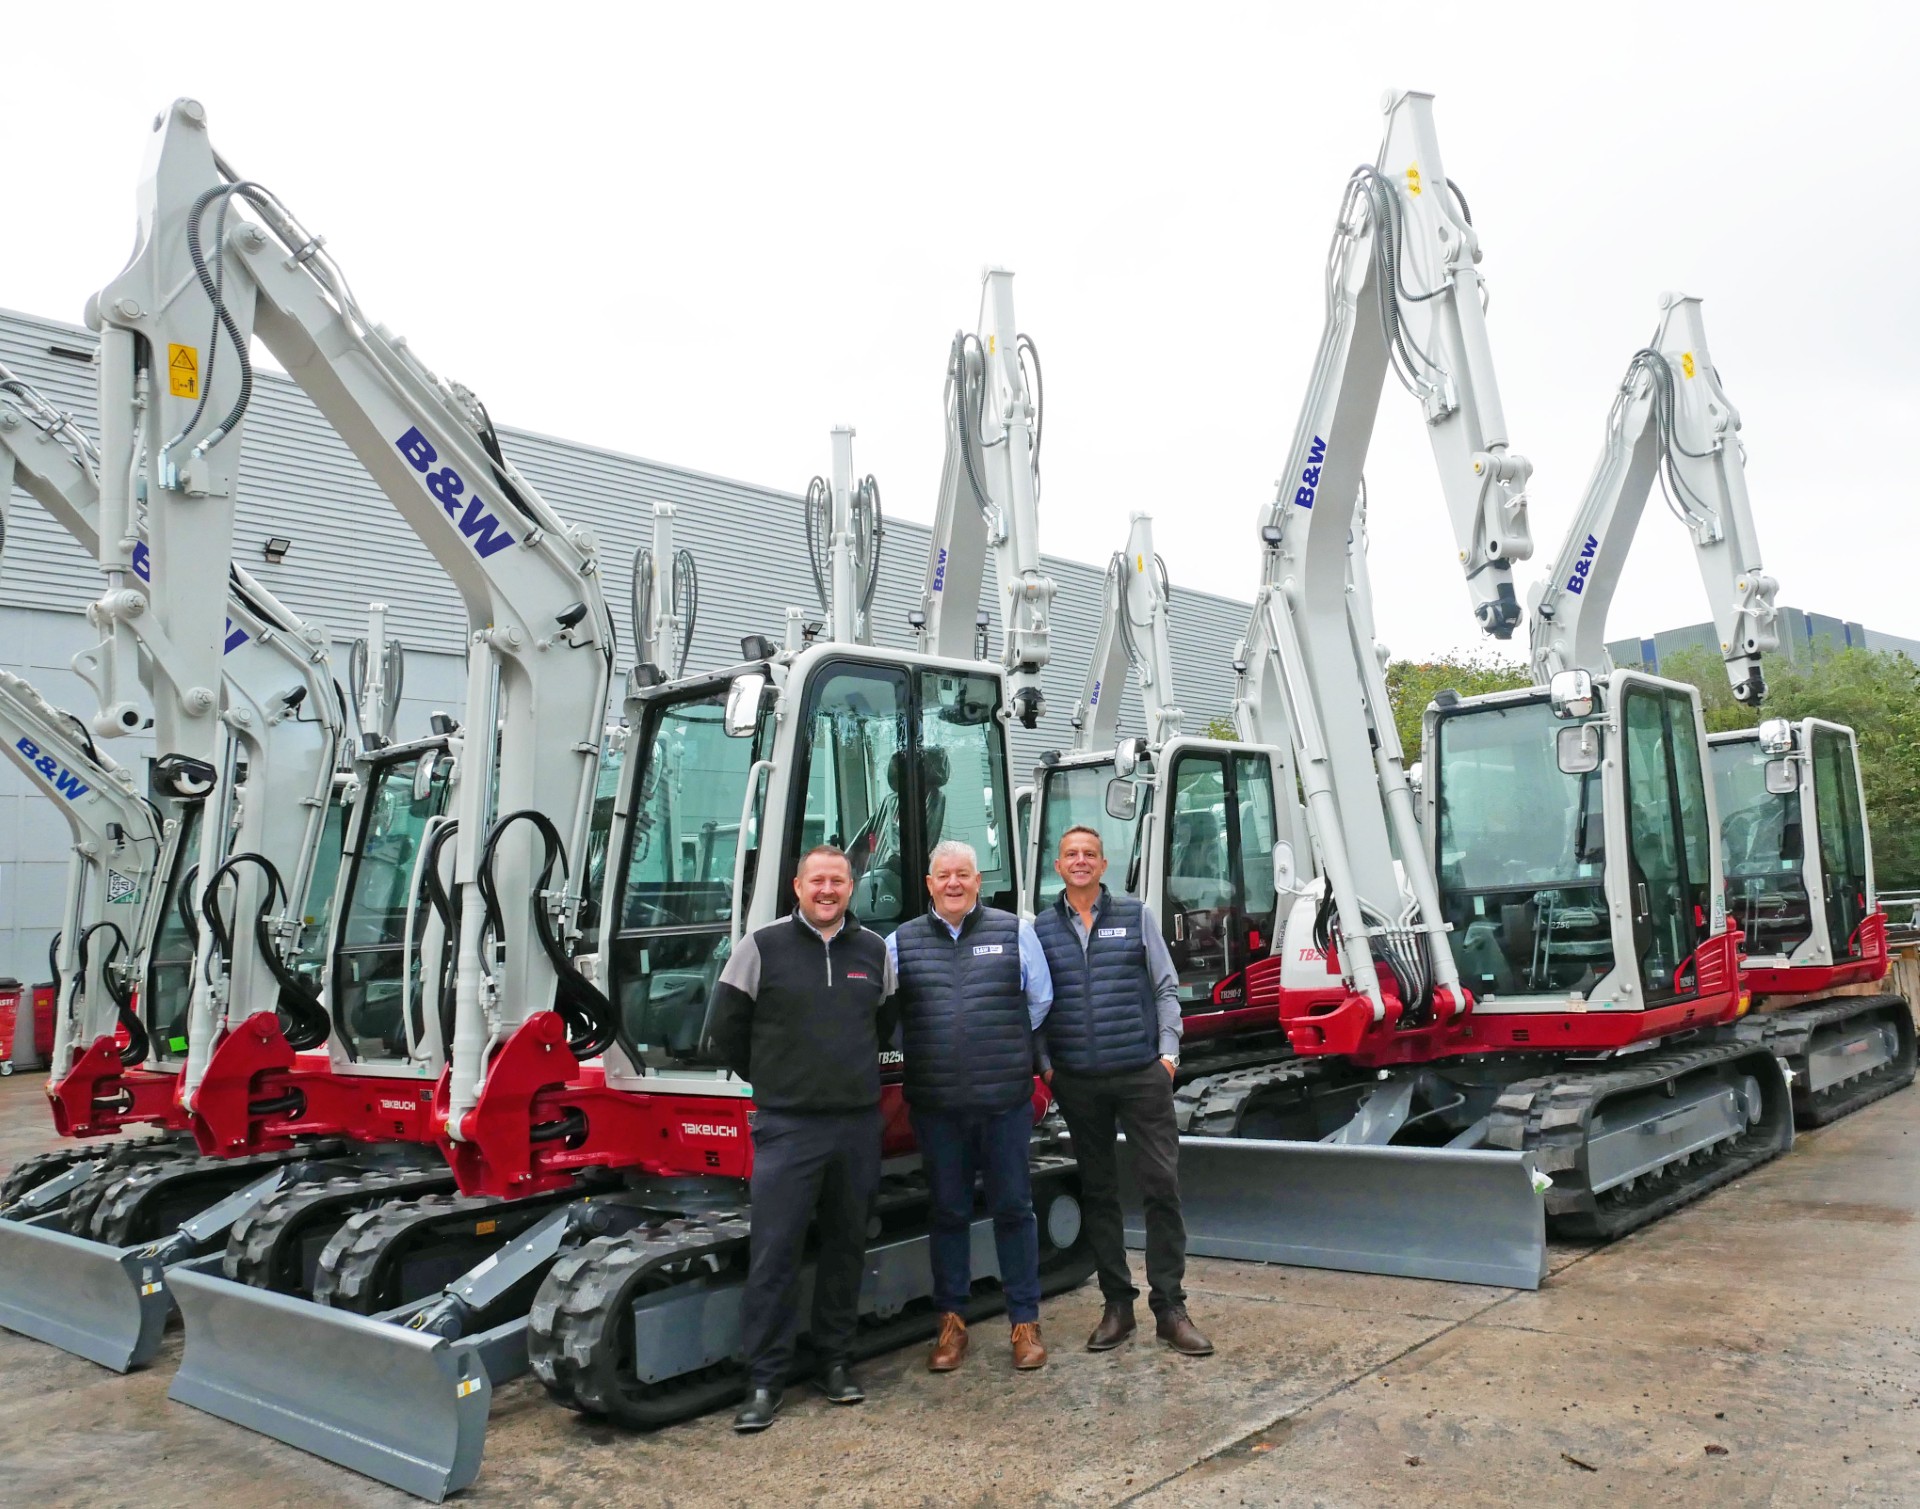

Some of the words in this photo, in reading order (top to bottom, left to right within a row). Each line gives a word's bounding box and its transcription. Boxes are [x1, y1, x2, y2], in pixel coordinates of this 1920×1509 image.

[396, 427, 516, 558] B&W
[1295, 436, 1327, 510] B&W
[933, 548, 947, 592] B&W
[1567, 534, 1598, 596] B&W
[1090, 681, 1101, 705] B&W
[16, 737, 90, 801] B&W
